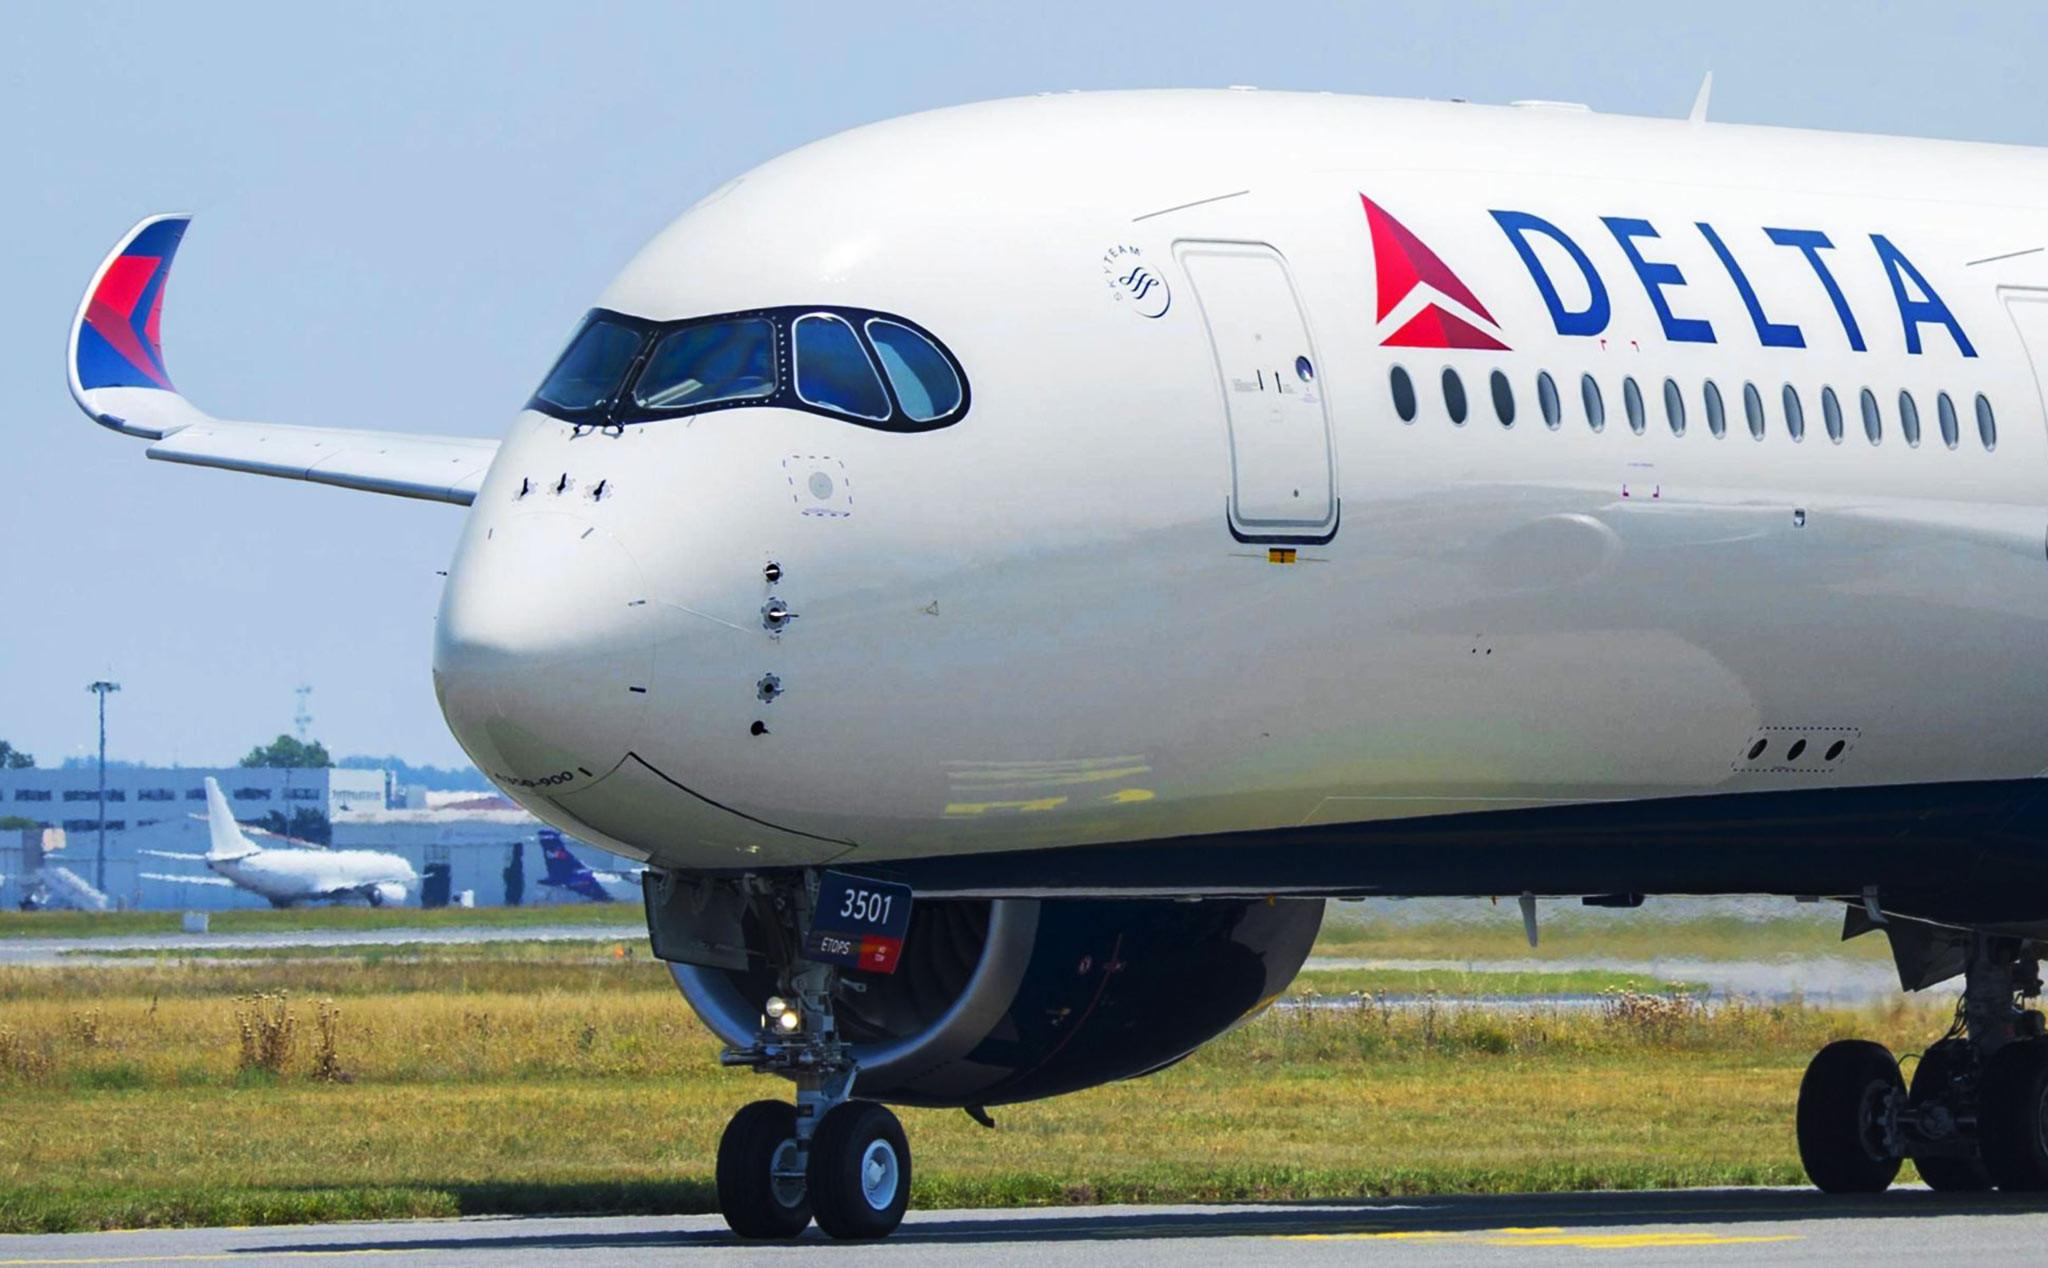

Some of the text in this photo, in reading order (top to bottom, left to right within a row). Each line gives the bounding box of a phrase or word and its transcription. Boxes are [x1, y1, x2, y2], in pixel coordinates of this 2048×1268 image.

[1488, 209, 1979, 357] DELTA
[840, 888, 892, 925] 3501
[820, 936, 851, 955] ETOPS
